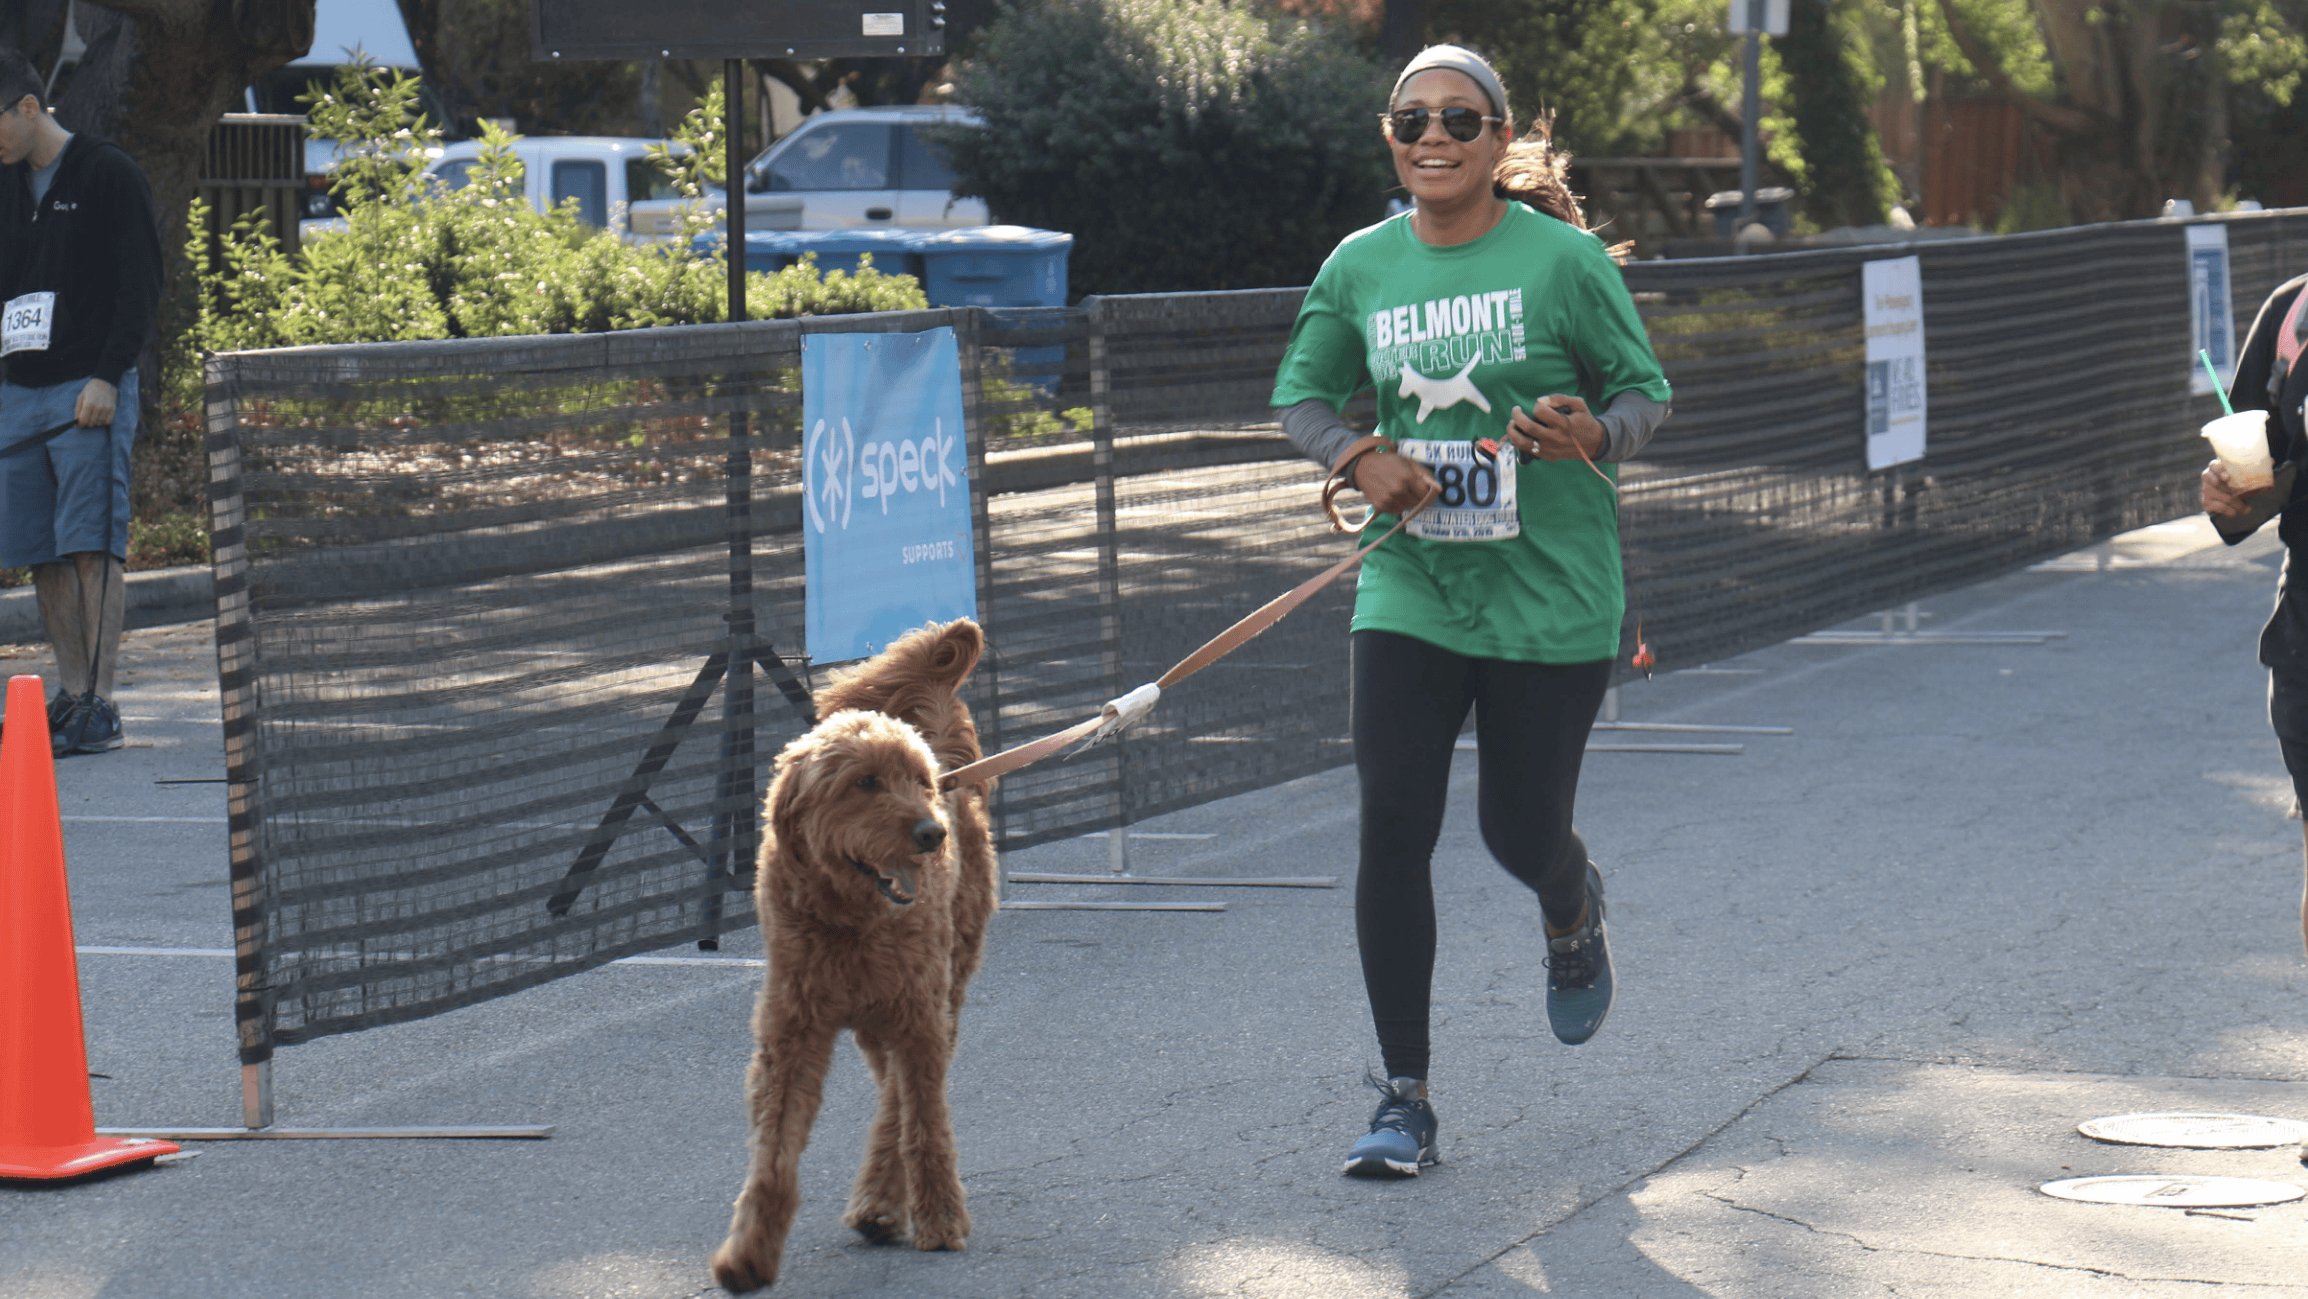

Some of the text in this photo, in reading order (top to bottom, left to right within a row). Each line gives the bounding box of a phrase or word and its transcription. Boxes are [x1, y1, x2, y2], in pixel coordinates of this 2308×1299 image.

[6, 307, 42, 332] 1364
[1376, 289, 1509, 350] BELMONT
[1420, 329, 1514, 375] RUN
[860, 416, 956, 516] speck
[1421, 462, 1498, 508] 80
[901, 540, 954, 565] SUPPORTS
